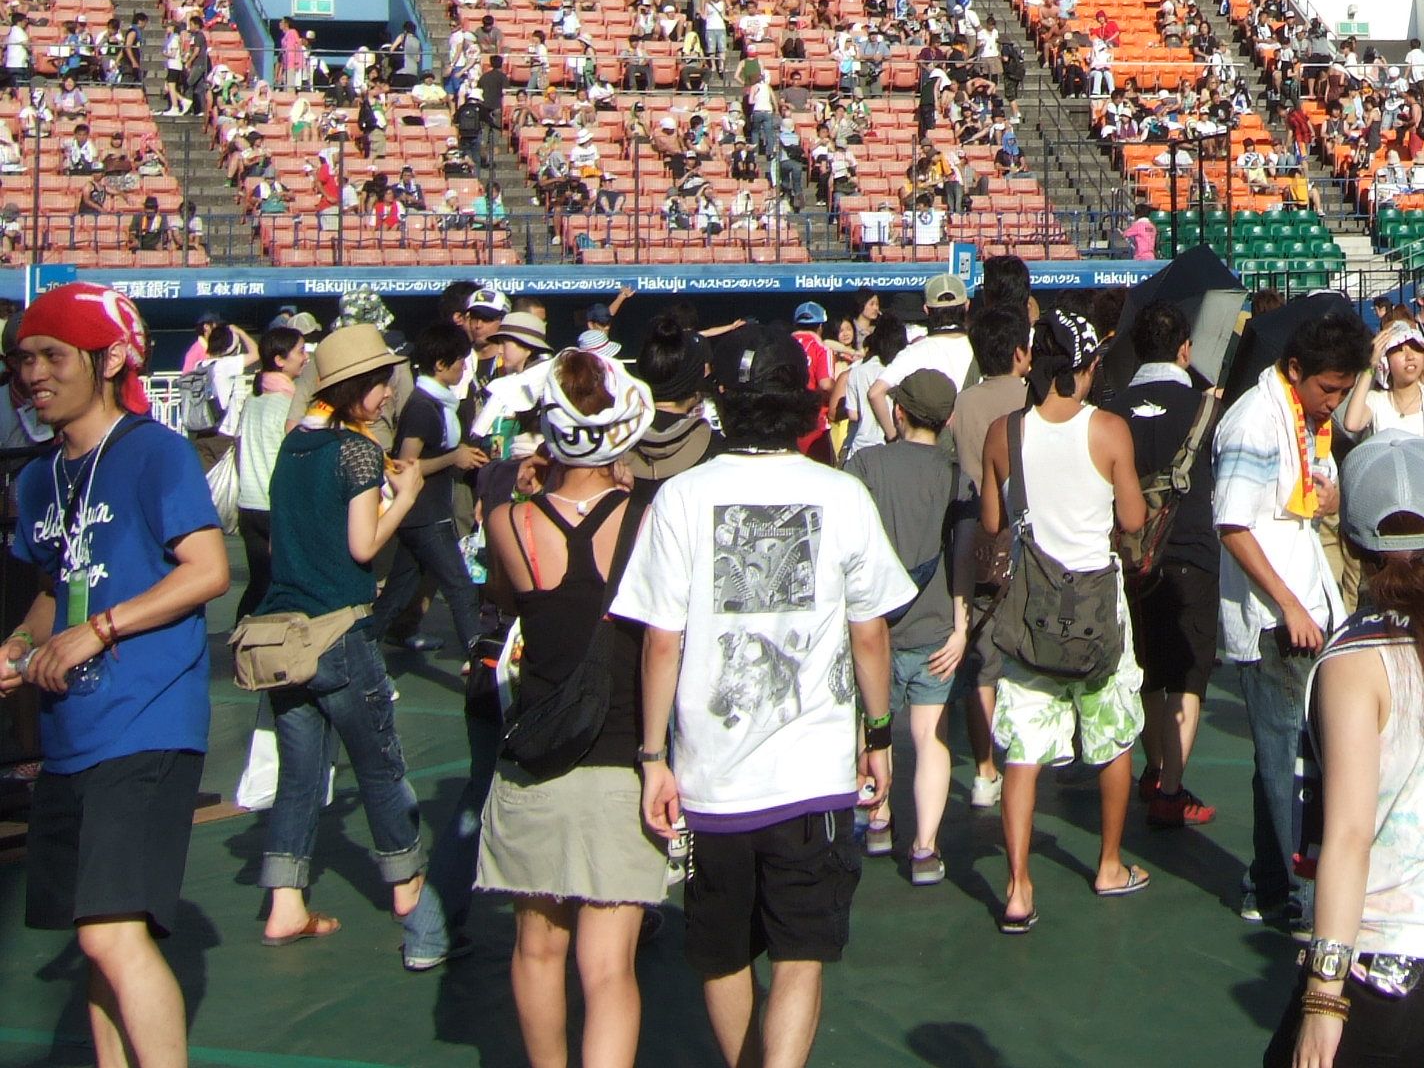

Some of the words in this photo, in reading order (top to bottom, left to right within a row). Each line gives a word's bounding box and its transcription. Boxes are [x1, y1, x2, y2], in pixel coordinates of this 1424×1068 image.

[305, 279, 357, 294] Hakuju
[637, 276, 686, 293] Hakuju
[795, 274, 843, 292] Hakuju
[845, 276, 928, 287] ヘルストロンのハクジ
[1094, 271, 1138, 288] Hakuju
